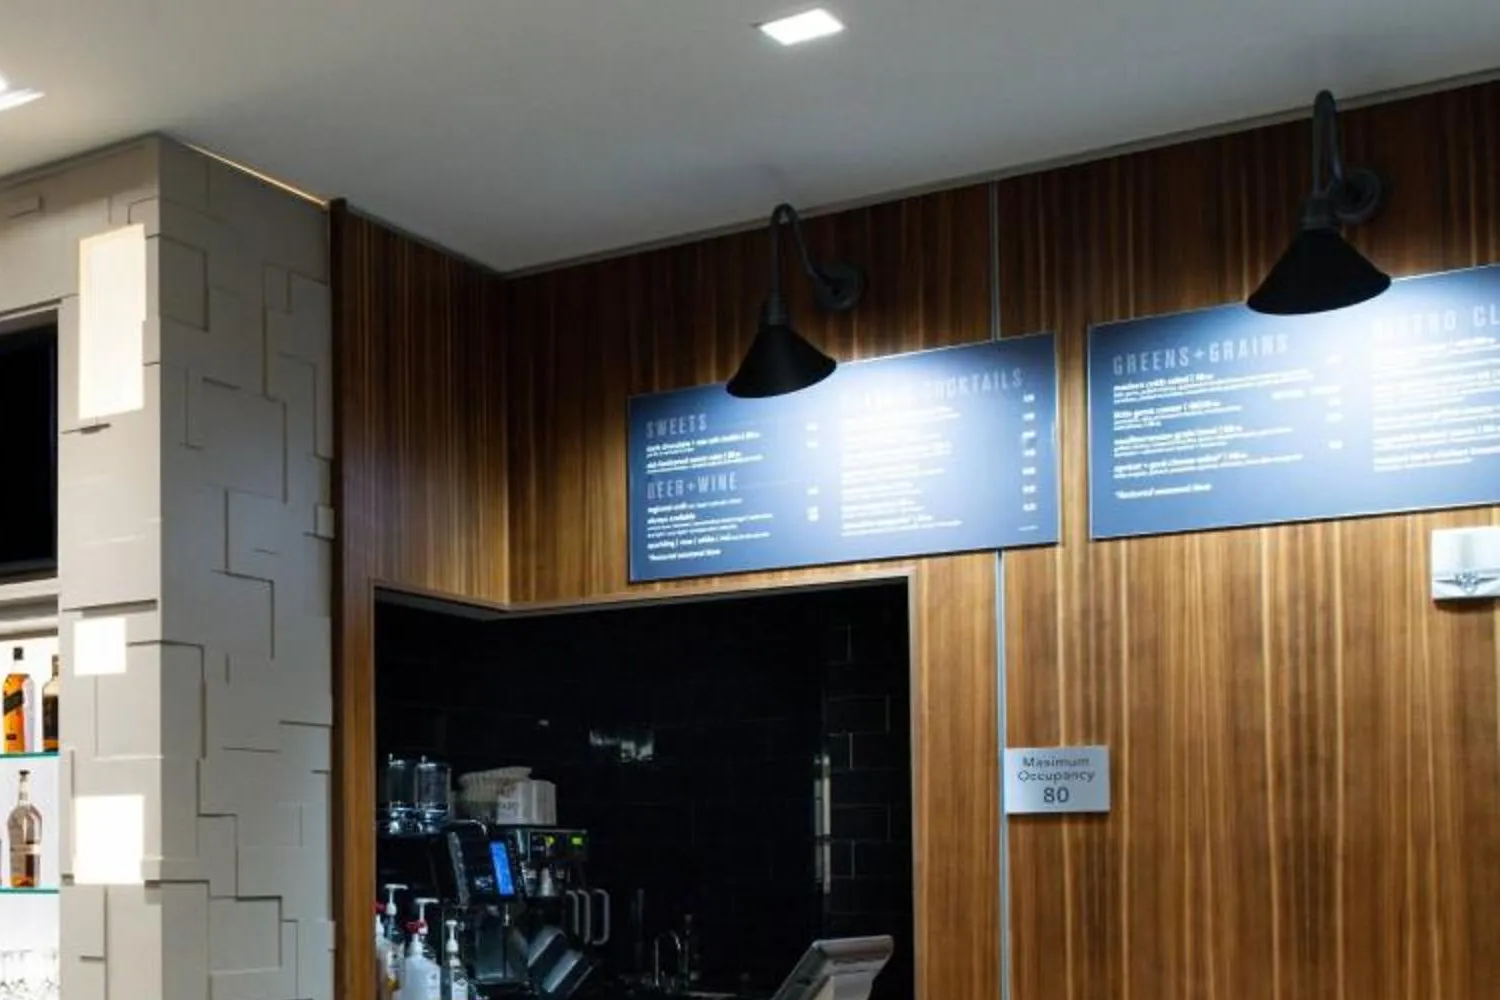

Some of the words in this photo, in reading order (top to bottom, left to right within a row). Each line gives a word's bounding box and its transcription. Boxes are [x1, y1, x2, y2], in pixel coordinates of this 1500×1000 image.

[1373, 308, 1457, 340] TRO
[646, 413, 708, 438] SWEETS
[1022, 756, 1090, 768] Maximum
[1018, 769, 1095, 784] Occupancy
[1043, 787, 1070, 803] 80
